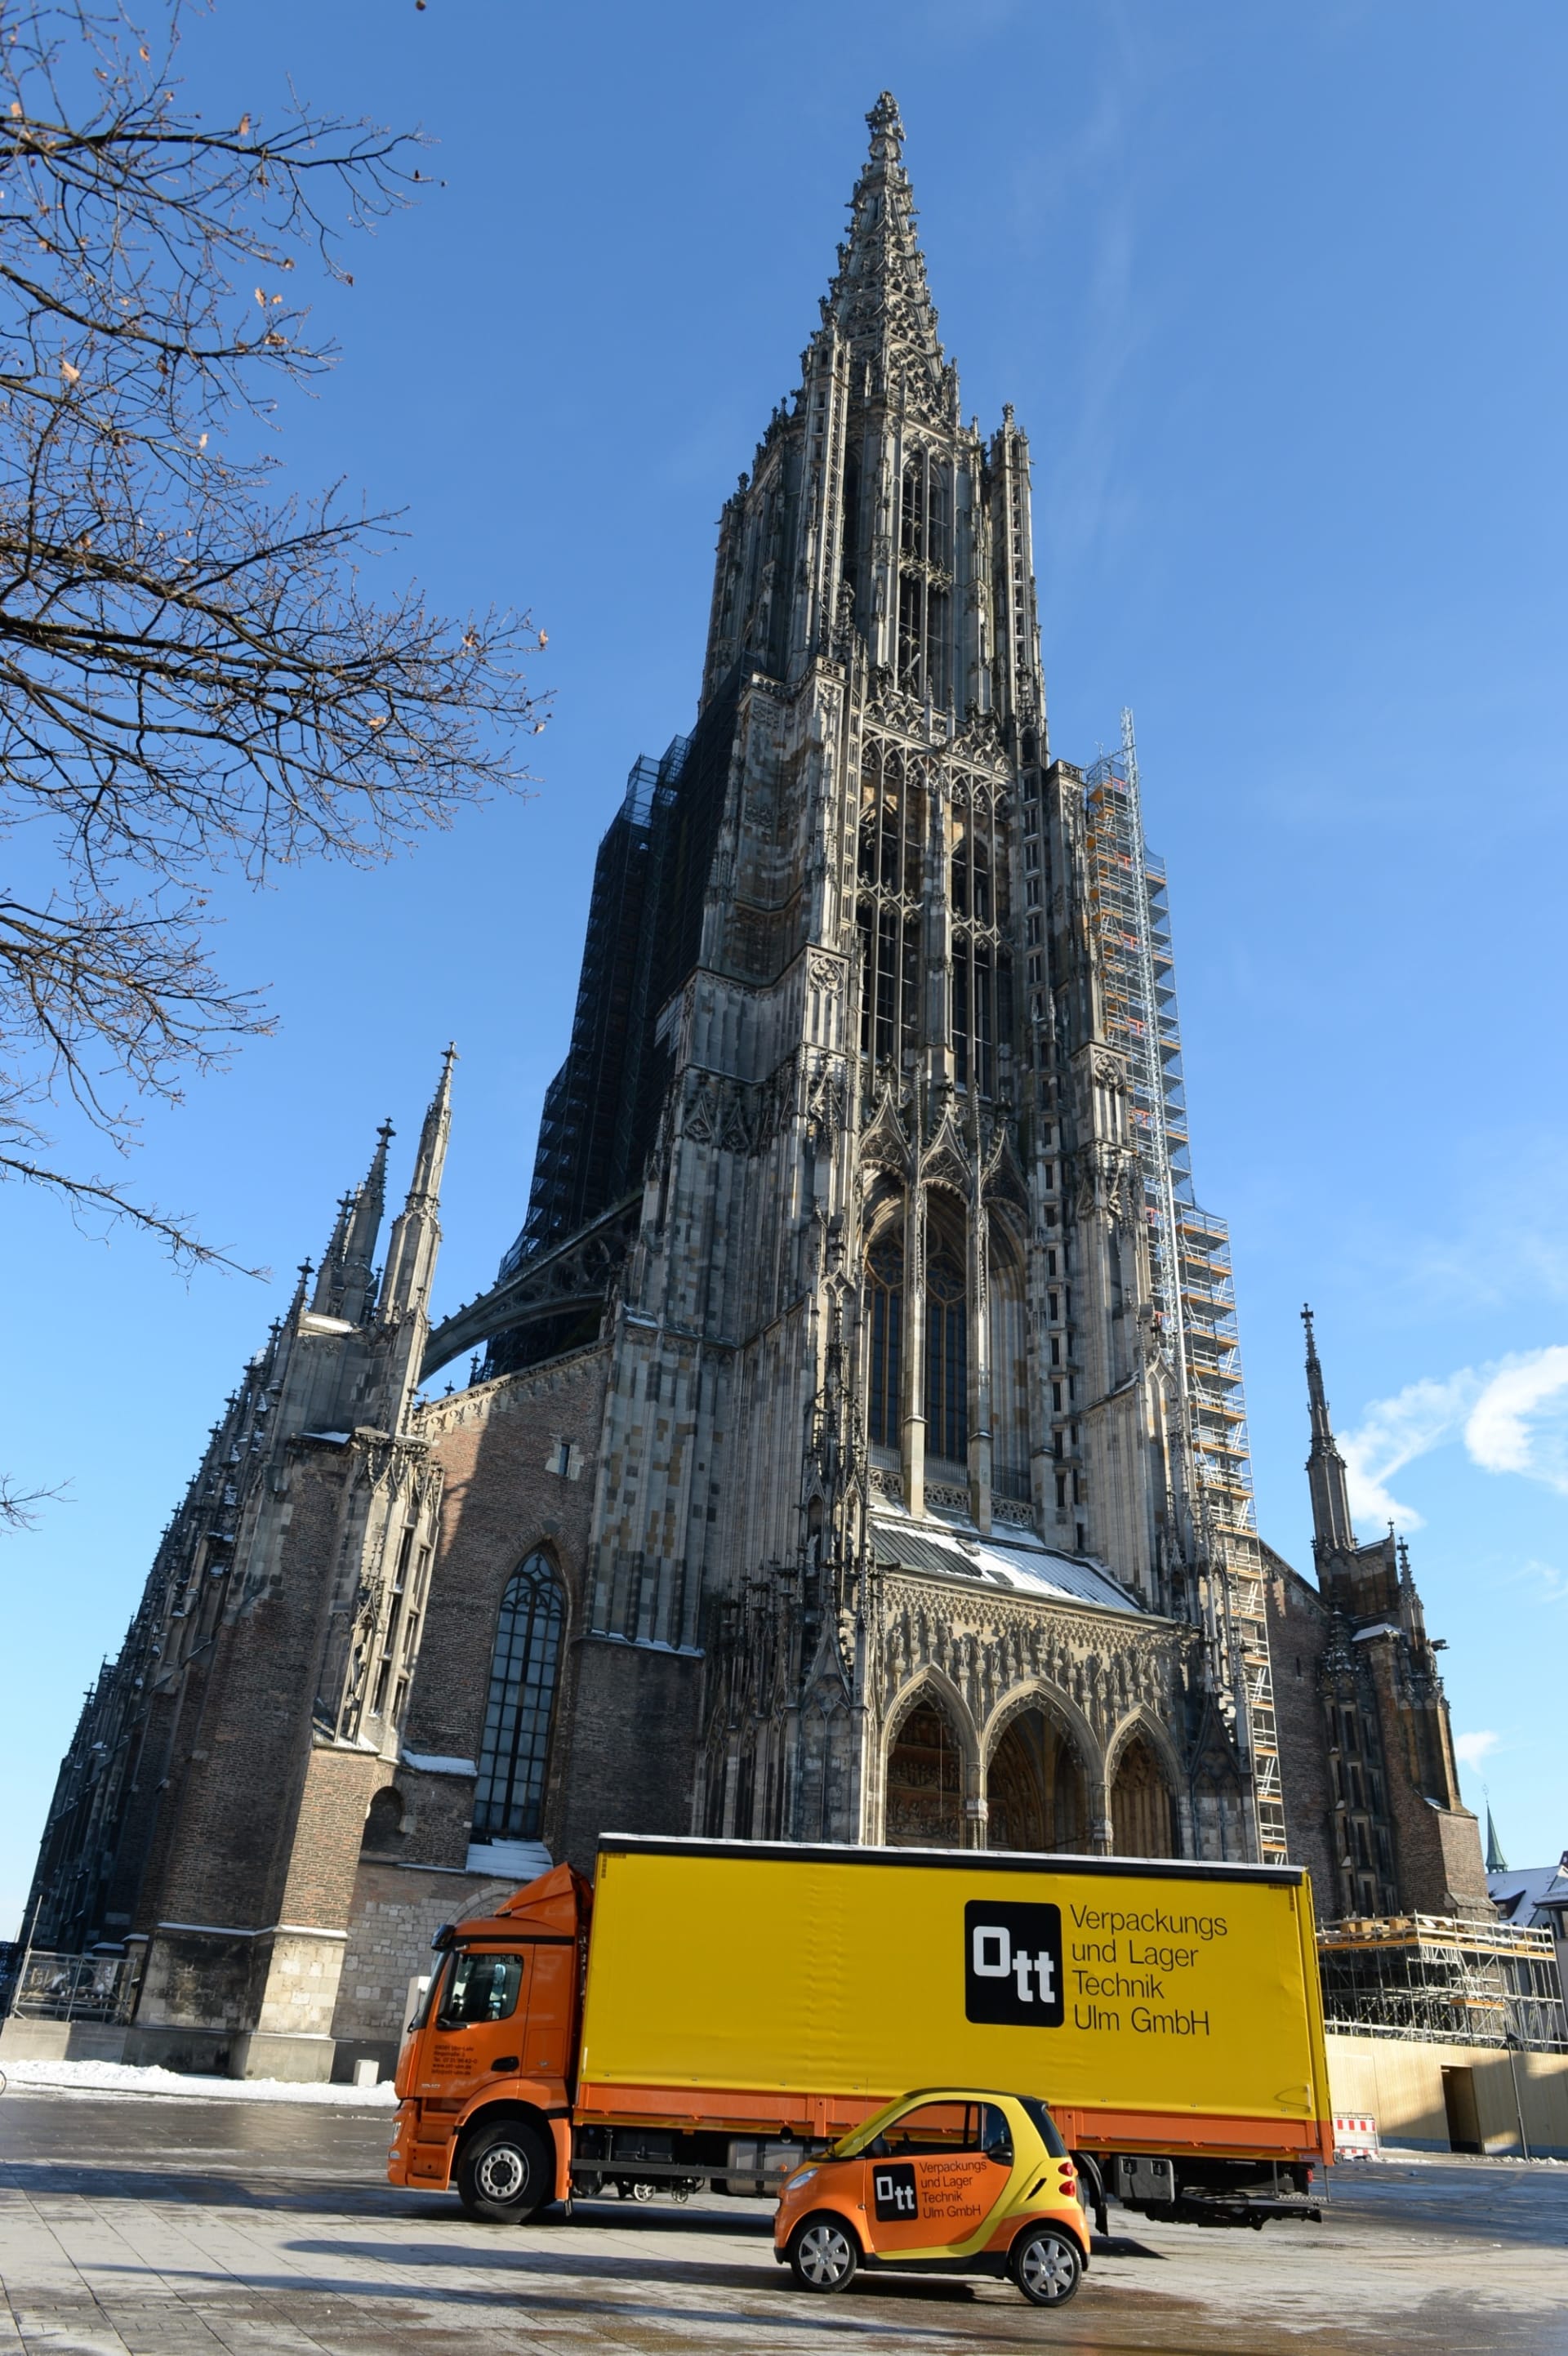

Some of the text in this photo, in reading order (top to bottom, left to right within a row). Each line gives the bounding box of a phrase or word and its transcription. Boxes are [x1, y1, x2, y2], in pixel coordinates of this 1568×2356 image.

[1070, 1904, 1227, 1940] Verpackungs
[973, 1926, 1055, 2003] Ott
[1071, 1940, 1199, 1971] und Lager
[1071, 1970, 1165, 1999] Technik
[1074, 2004, 1209, 2036] Ulm GmbH
[919, 2161, 987, 2175] Verpackungs
[920, 2176, 973, 2189] und Lager
[876, 2176, 915, 2210] Ott
[921, 2190, 962, 2203] Technik
[923, 2204, 981, 2219] Ulm GmbH
